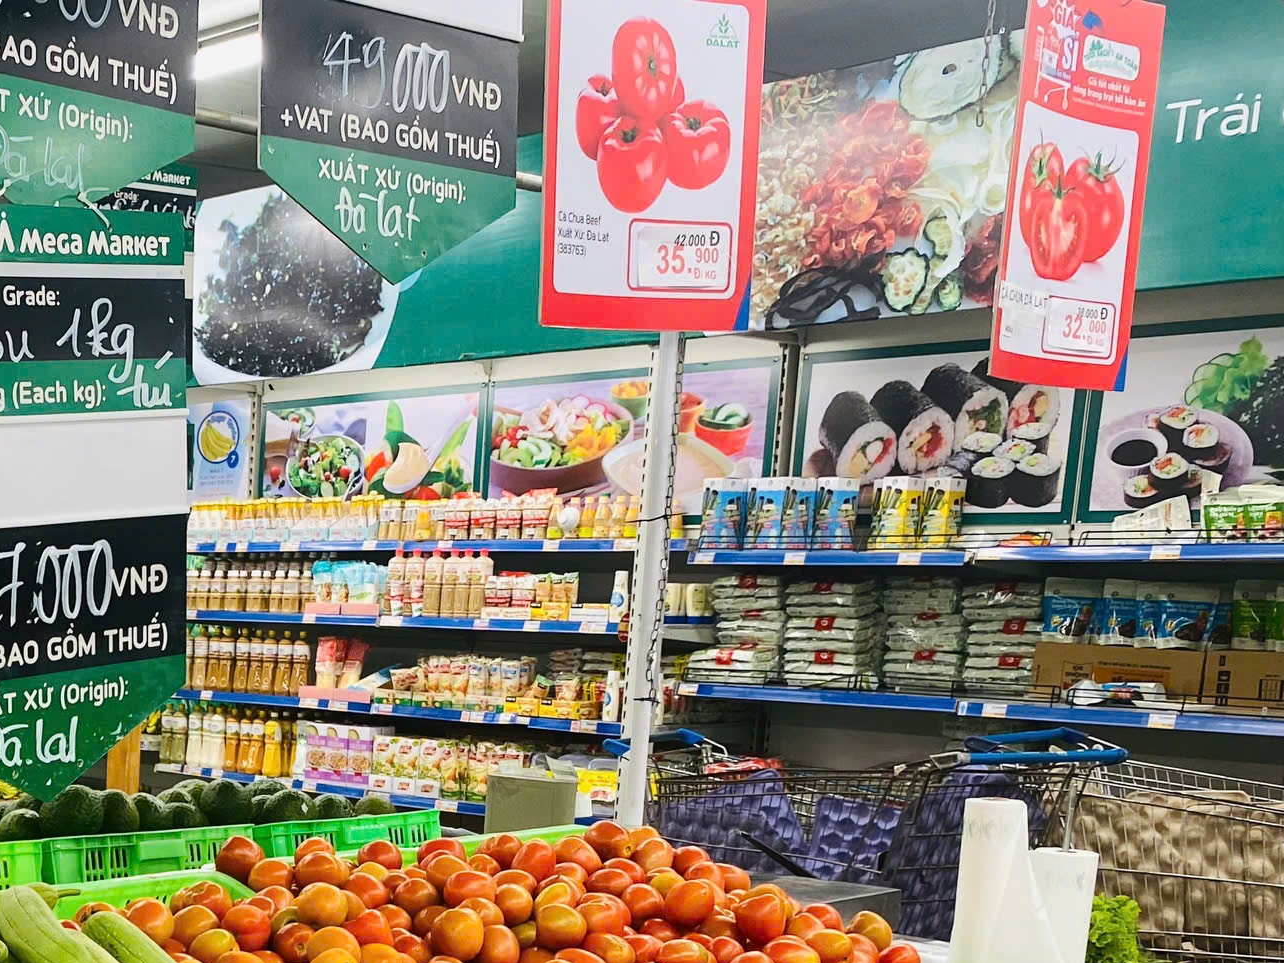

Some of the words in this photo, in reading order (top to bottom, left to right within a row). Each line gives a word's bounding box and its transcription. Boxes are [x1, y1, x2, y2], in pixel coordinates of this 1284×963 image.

[705, 38, 740, 49] DALAT
[45, 36, 99, 81] GỒM
[108, 59, 178, 104] THUẾ)
[451, 75, 502, 111] VNĐ
[19, 93, 52, 121] XỨ
[58, 102, 134, 141] (Origin):
[1166, 93, 1261, 144] Trái
[281, 104, 333, 134] +VAT
[340, 112, 389, 144] (BAO
[395, 115, 438, 154] GỒM
[444, 129, 502, 169] THUẾ)
[318, 152, 369, 182] XUẤT
[375, 167, 401, 190] XỨ
[406, 177, 467, 205] (Origin):
[568, 212, 585, 224] Chua
[586, 214, 602, 226] Beef
[673, 233, 706, 247] 42.000
[3, 285, 61, 307] Grade:
[11, 379, 69, 409] (Each
[73, 377, 107, 407] kg):
[110, 563, 168, 597] VNĐ
[47, 621, 96, 662] GỒM
[103, 612, 168, 654] THUẾ)
[23, 681, 53, 711] XỨ
[60, 679, 129, 710] (Origin):
